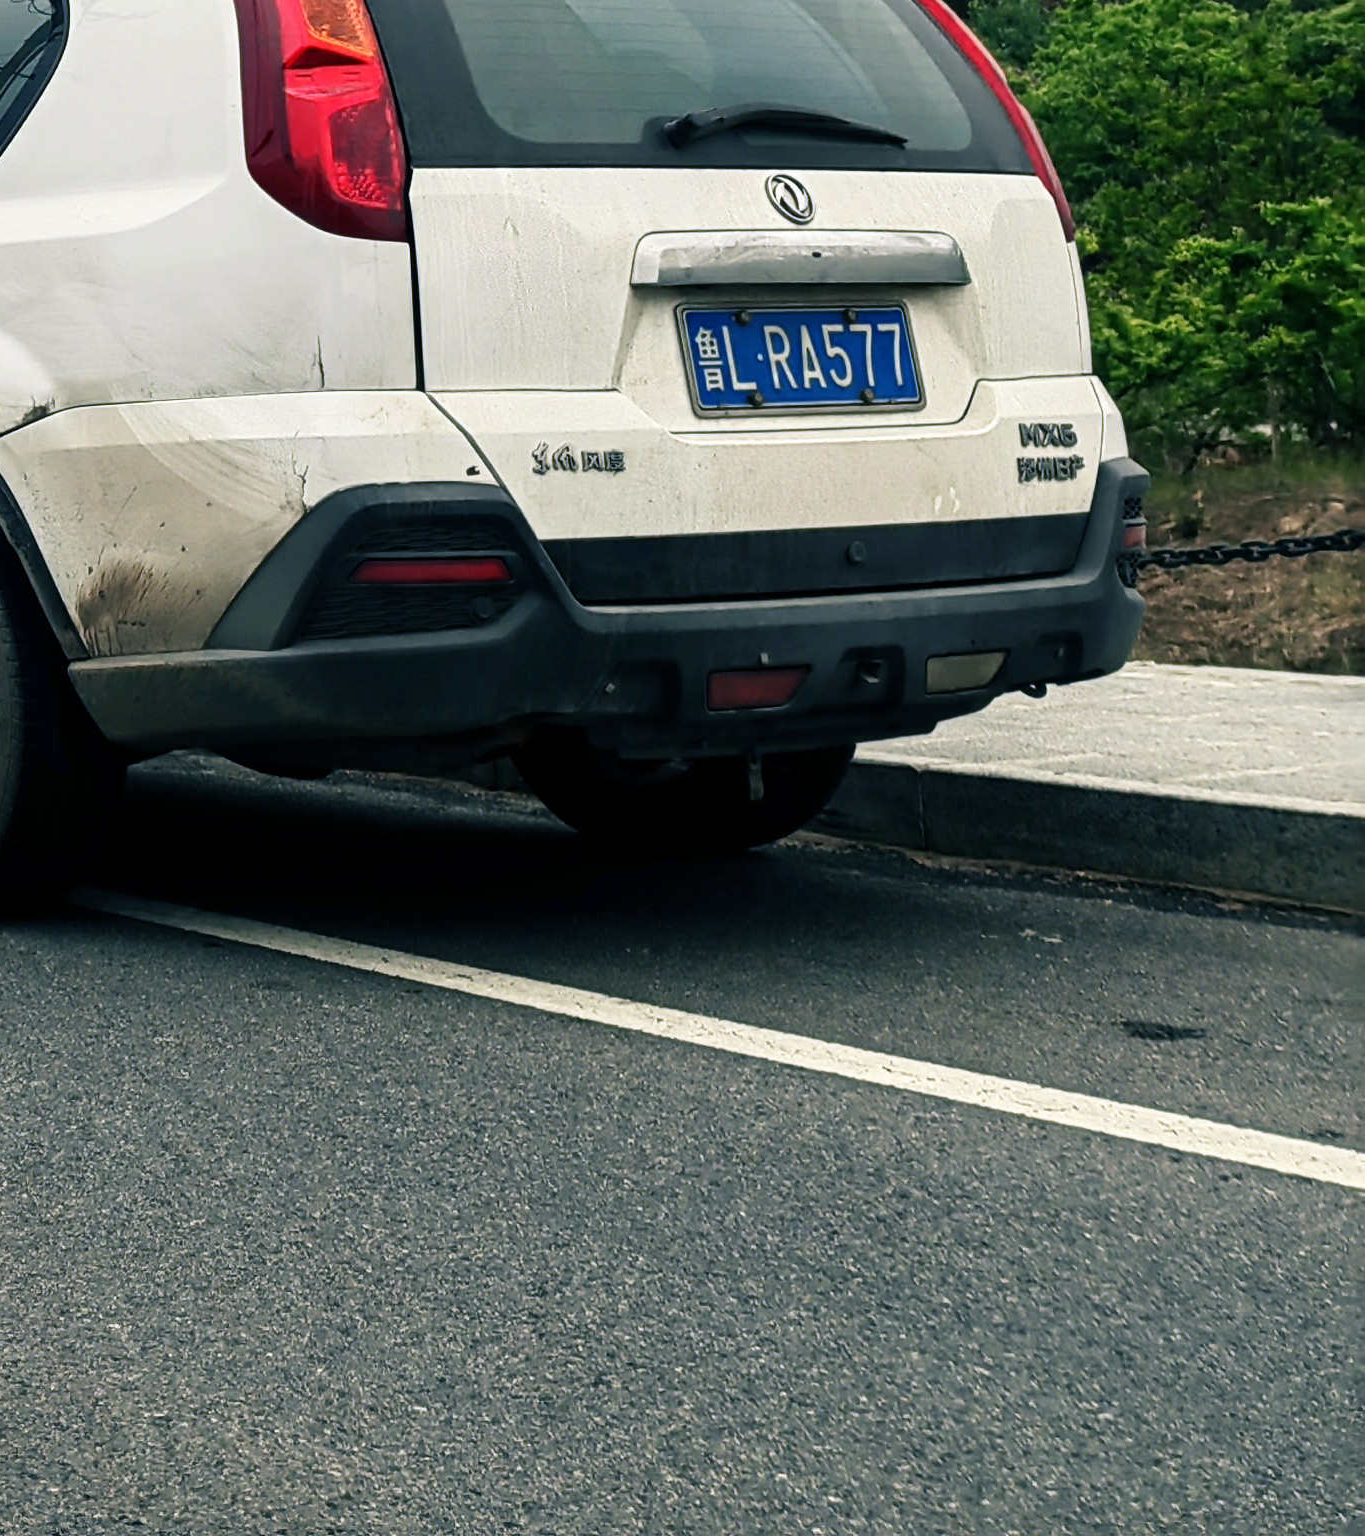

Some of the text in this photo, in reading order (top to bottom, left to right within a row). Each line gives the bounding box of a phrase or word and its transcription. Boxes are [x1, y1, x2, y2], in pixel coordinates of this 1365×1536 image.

[1018, 422, 1078, 448] MX6
[1016, 454, 1086, 483] 郑州日产
